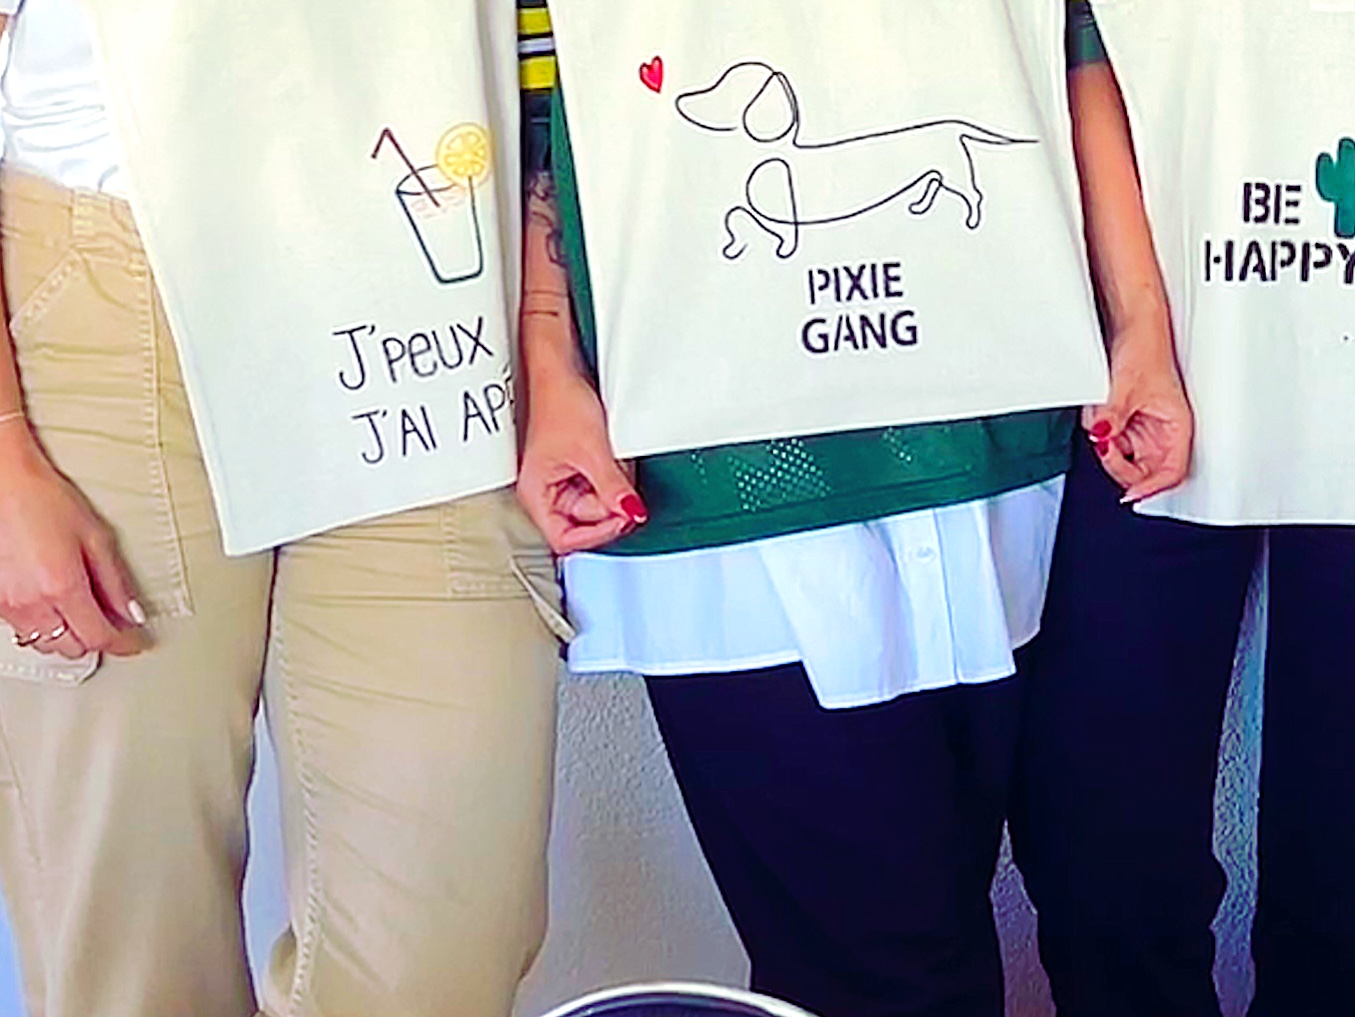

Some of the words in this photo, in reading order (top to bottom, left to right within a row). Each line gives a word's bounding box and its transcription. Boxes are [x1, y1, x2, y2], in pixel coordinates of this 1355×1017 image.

[1243, 182, 1302, 225] BE
[808, 262, 904, 305] PIXIE
[801, 309, 918, 354] GANG
[352, 405, 437, 464] J'AI
